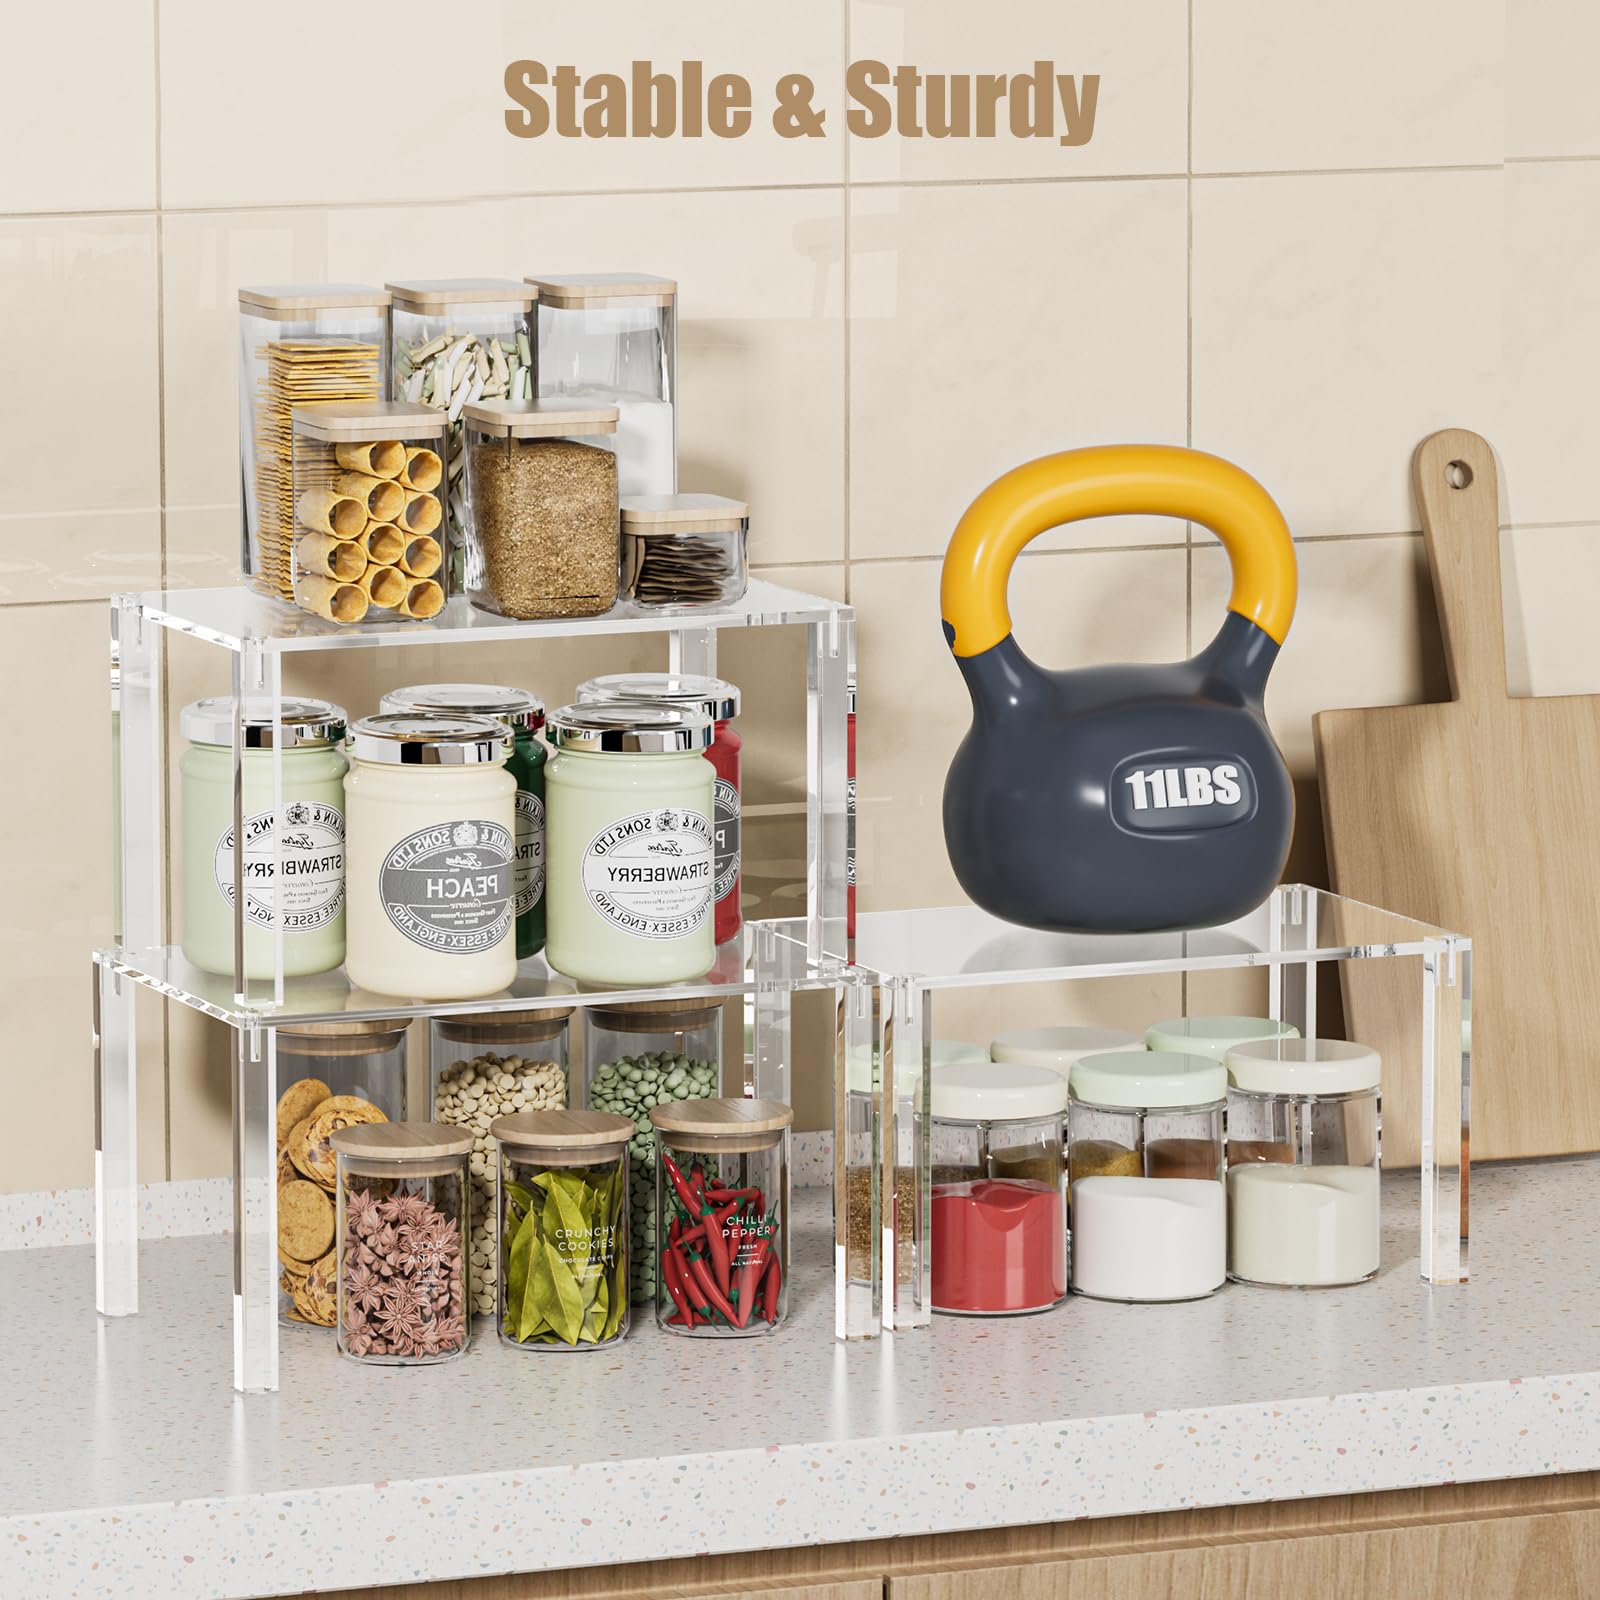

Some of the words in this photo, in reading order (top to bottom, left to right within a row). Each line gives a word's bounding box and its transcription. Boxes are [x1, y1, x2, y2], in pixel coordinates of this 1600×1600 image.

[1125, 764, 1241, 810] 11LBS
[726, 1213, 768, 1226] CHILLI
[555, 1225, 616, 1239] CRUNCHY
[722, 1225, 771, 1239] PEPPER
[411, 1240, 443, 1251] STAR
[558, 1237, 614, 1251] COOKIES
